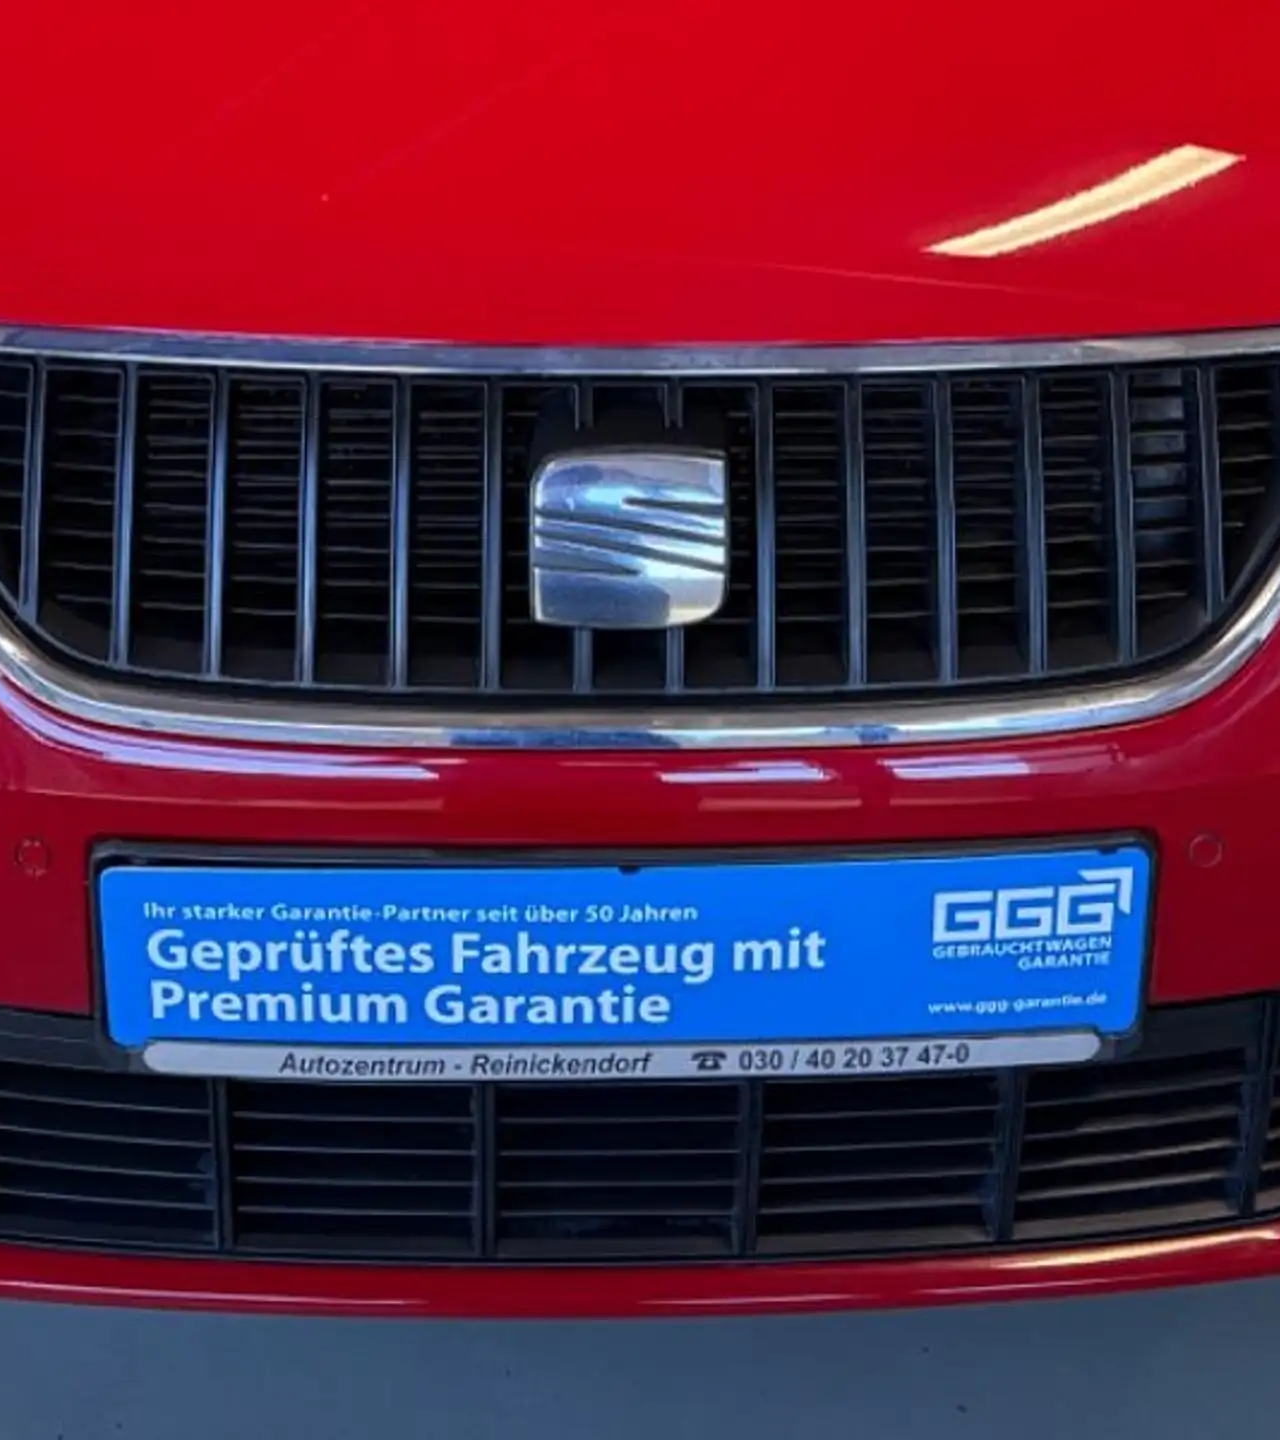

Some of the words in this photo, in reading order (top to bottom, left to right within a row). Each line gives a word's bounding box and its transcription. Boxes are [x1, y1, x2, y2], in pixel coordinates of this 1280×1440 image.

[143, 902, 175, 920] Ihr
[181, 902, 264, 921] starker
[271, 902, 471, 923] Garantie-Partner
[476, 906, 519, 923] seit
[524, 904, 578, 923] über
[585, 905, 613, 923] 50
[618, 903, 698, 922] Jahren
[932, 882, 1116, 943] GGG
[147, 928, 434, 982] Geprüftes
[451, 931, 715, 984] Fahrzeug
[733, 926, 826, 971] mit
[932, 935, 1113, 960] GEBRAUCHTWAGEN
[1018, 951, 1111, 971] GARANTIE
[150, 979, 408, 1023] Premium
[424, 984, 671, 1025] Garantie
[279, 1051, 446, 1077] Autozentrum
[470, 1052, 653, 1077] Reinickendorf
[738, 1049, 785, 1072] 030
[805, 1048, 836, 1070] 40
[843, 1046, 873, 1069] 20
[881, 1045, 910, 1068] 37
[917, 1041, 970, 1065] 47-0
